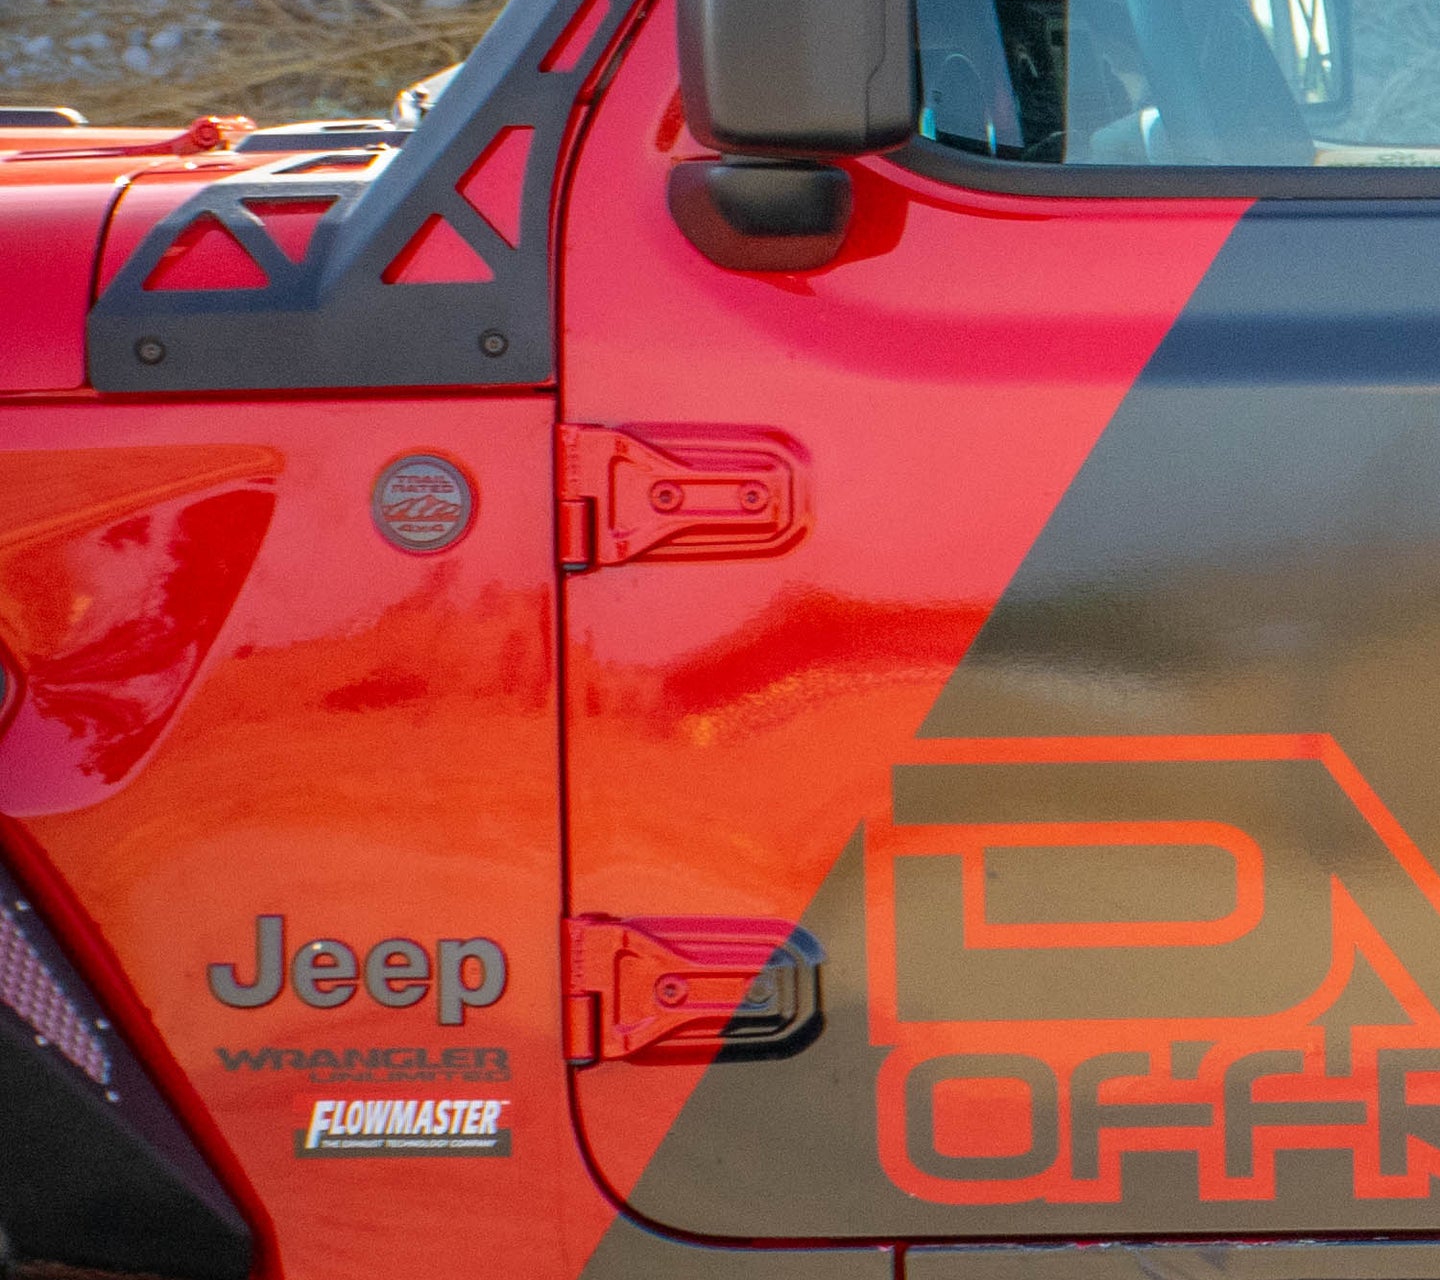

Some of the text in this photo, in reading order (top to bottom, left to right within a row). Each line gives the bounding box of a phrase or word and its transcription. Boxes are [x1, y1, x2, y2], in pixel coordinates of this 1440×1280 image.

[207, 914, 508, 1026] Jeep
[215, 1046, 510, 1071] WRANGLER
[310, 1070, 512, 1084] UNLIMITED
[305, 1099, 501, 1150] FLOWMASTER
